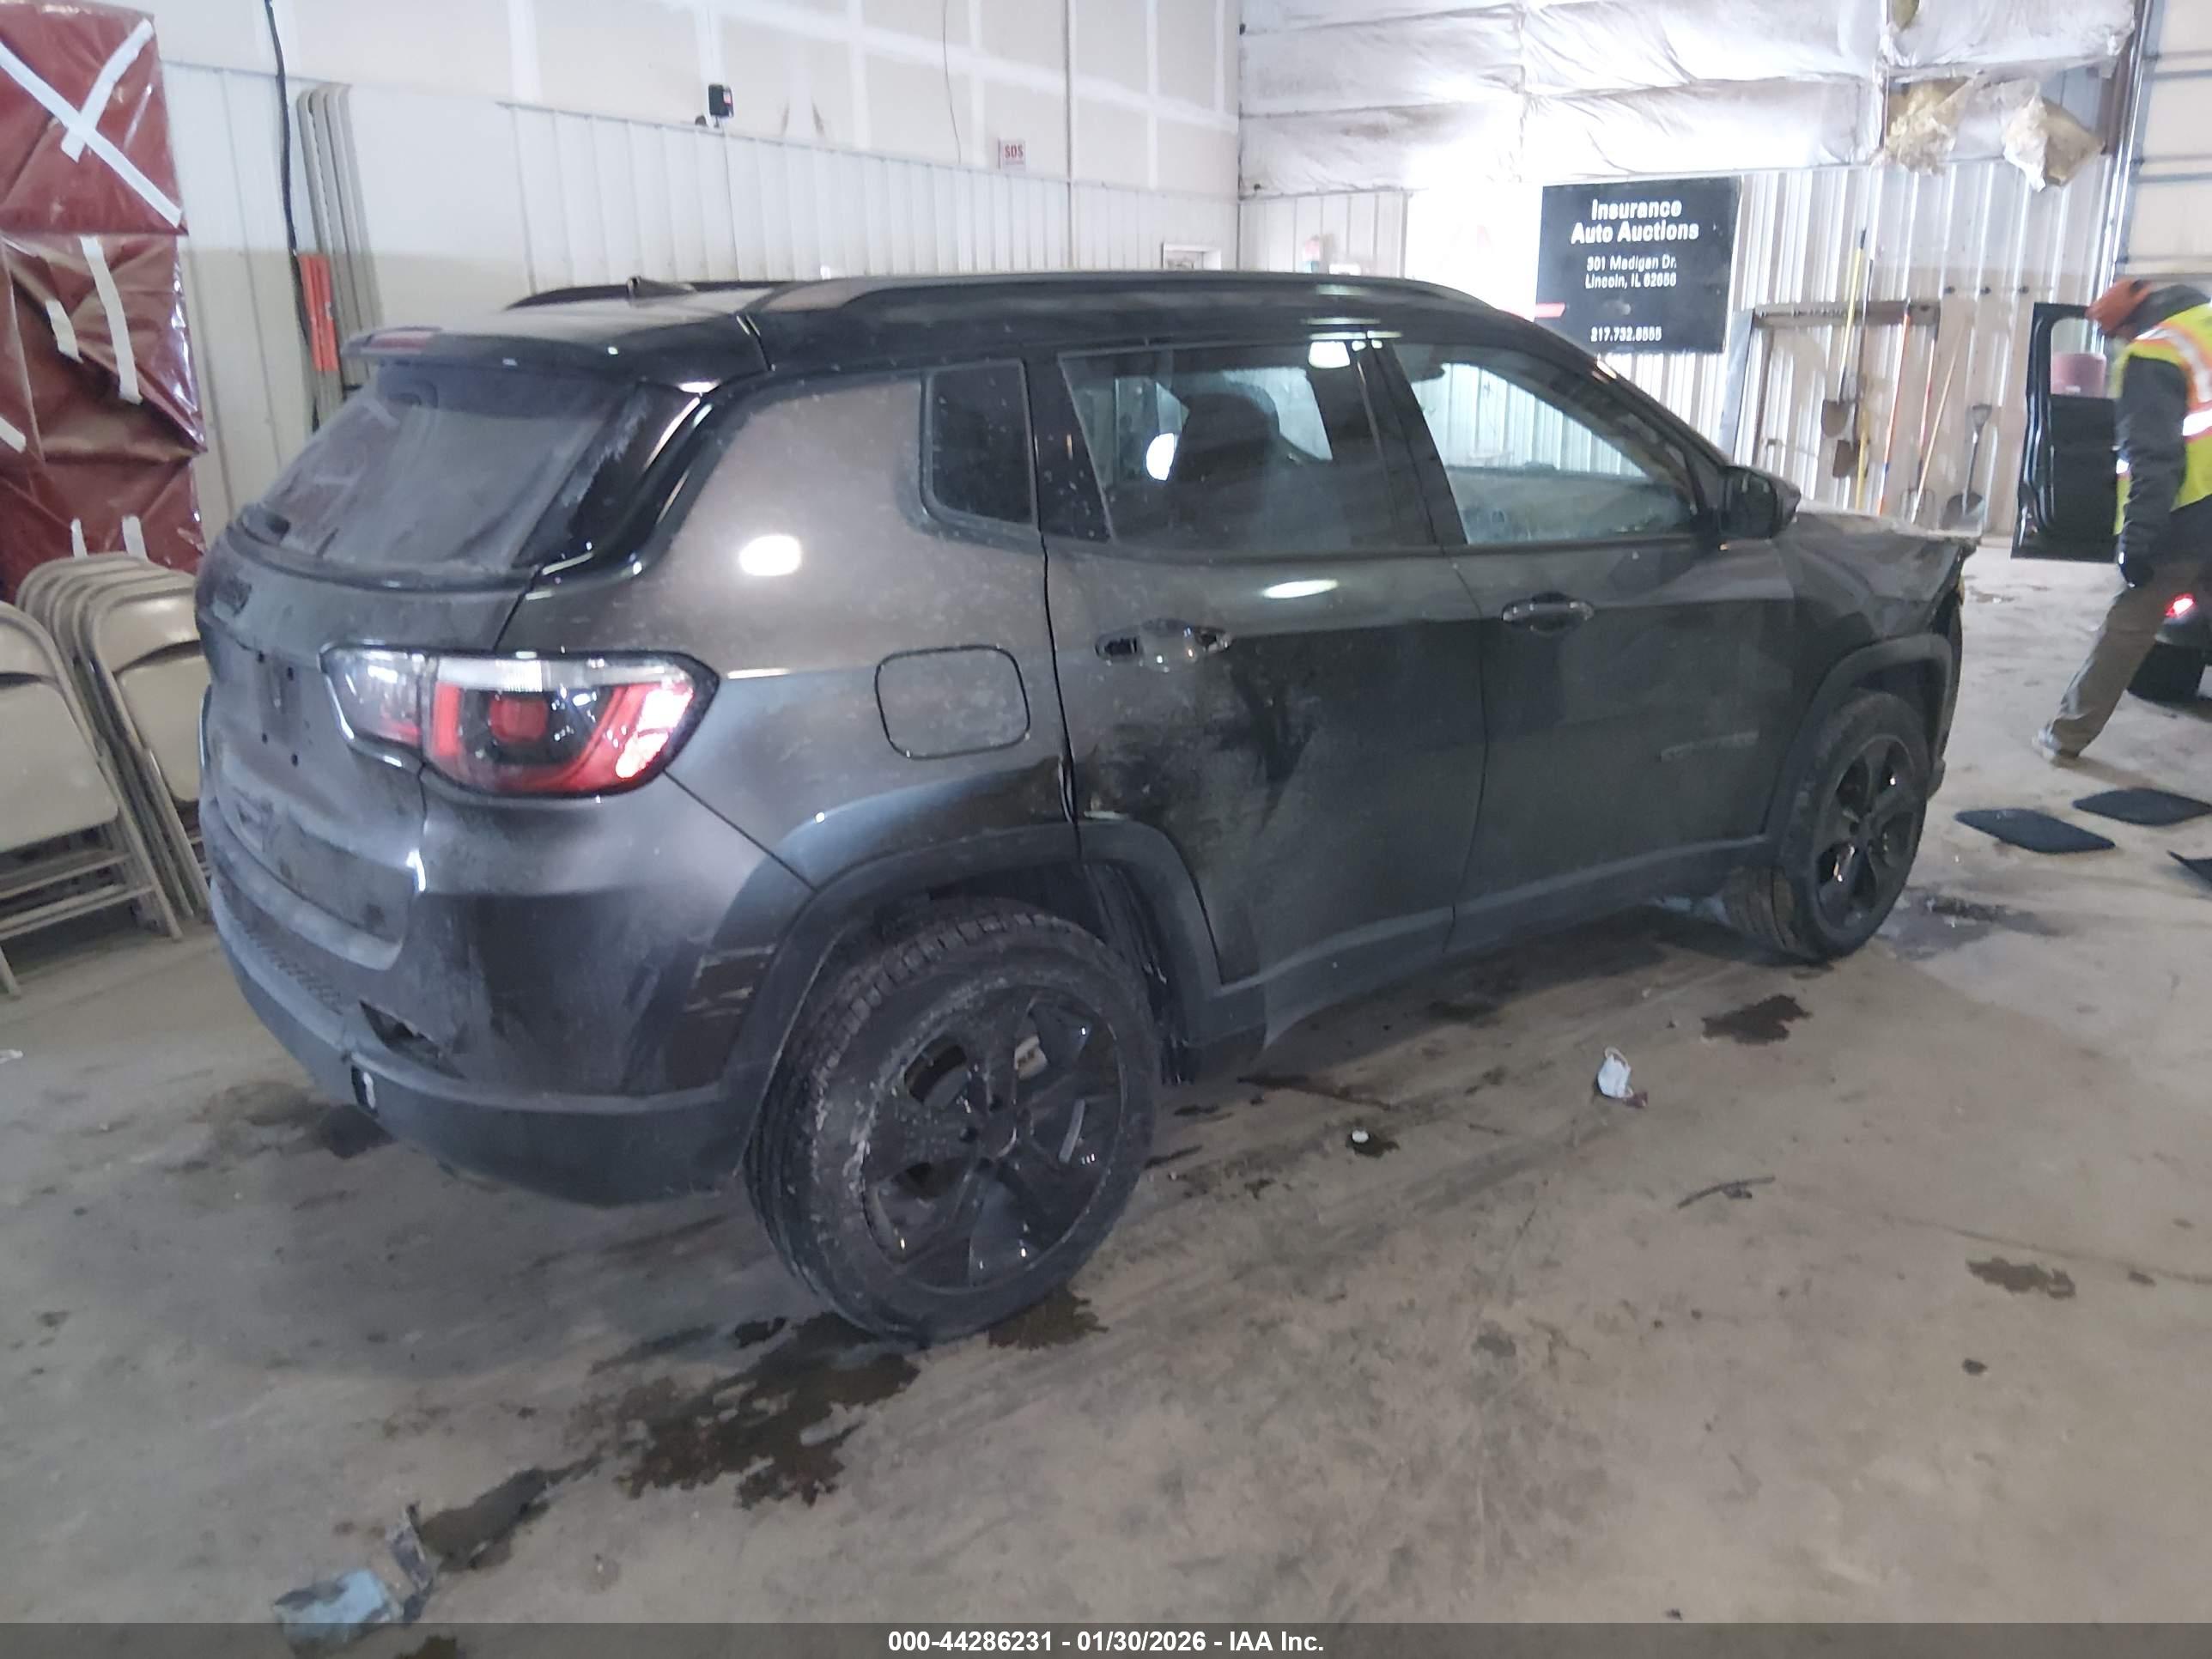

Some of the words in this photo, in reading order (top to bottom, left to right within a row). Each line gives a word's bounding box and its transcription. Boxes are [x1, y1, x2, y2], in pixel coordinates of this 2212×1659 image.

[1591, 198, 1682, 220] Insurance
[1571, 222, 1613, 244] Auto
[1617, 219, 1699, 242] Auctions
[1585, 273, 1628, 289] Lincoln,
[1631, 272, 1641, 288] IL
